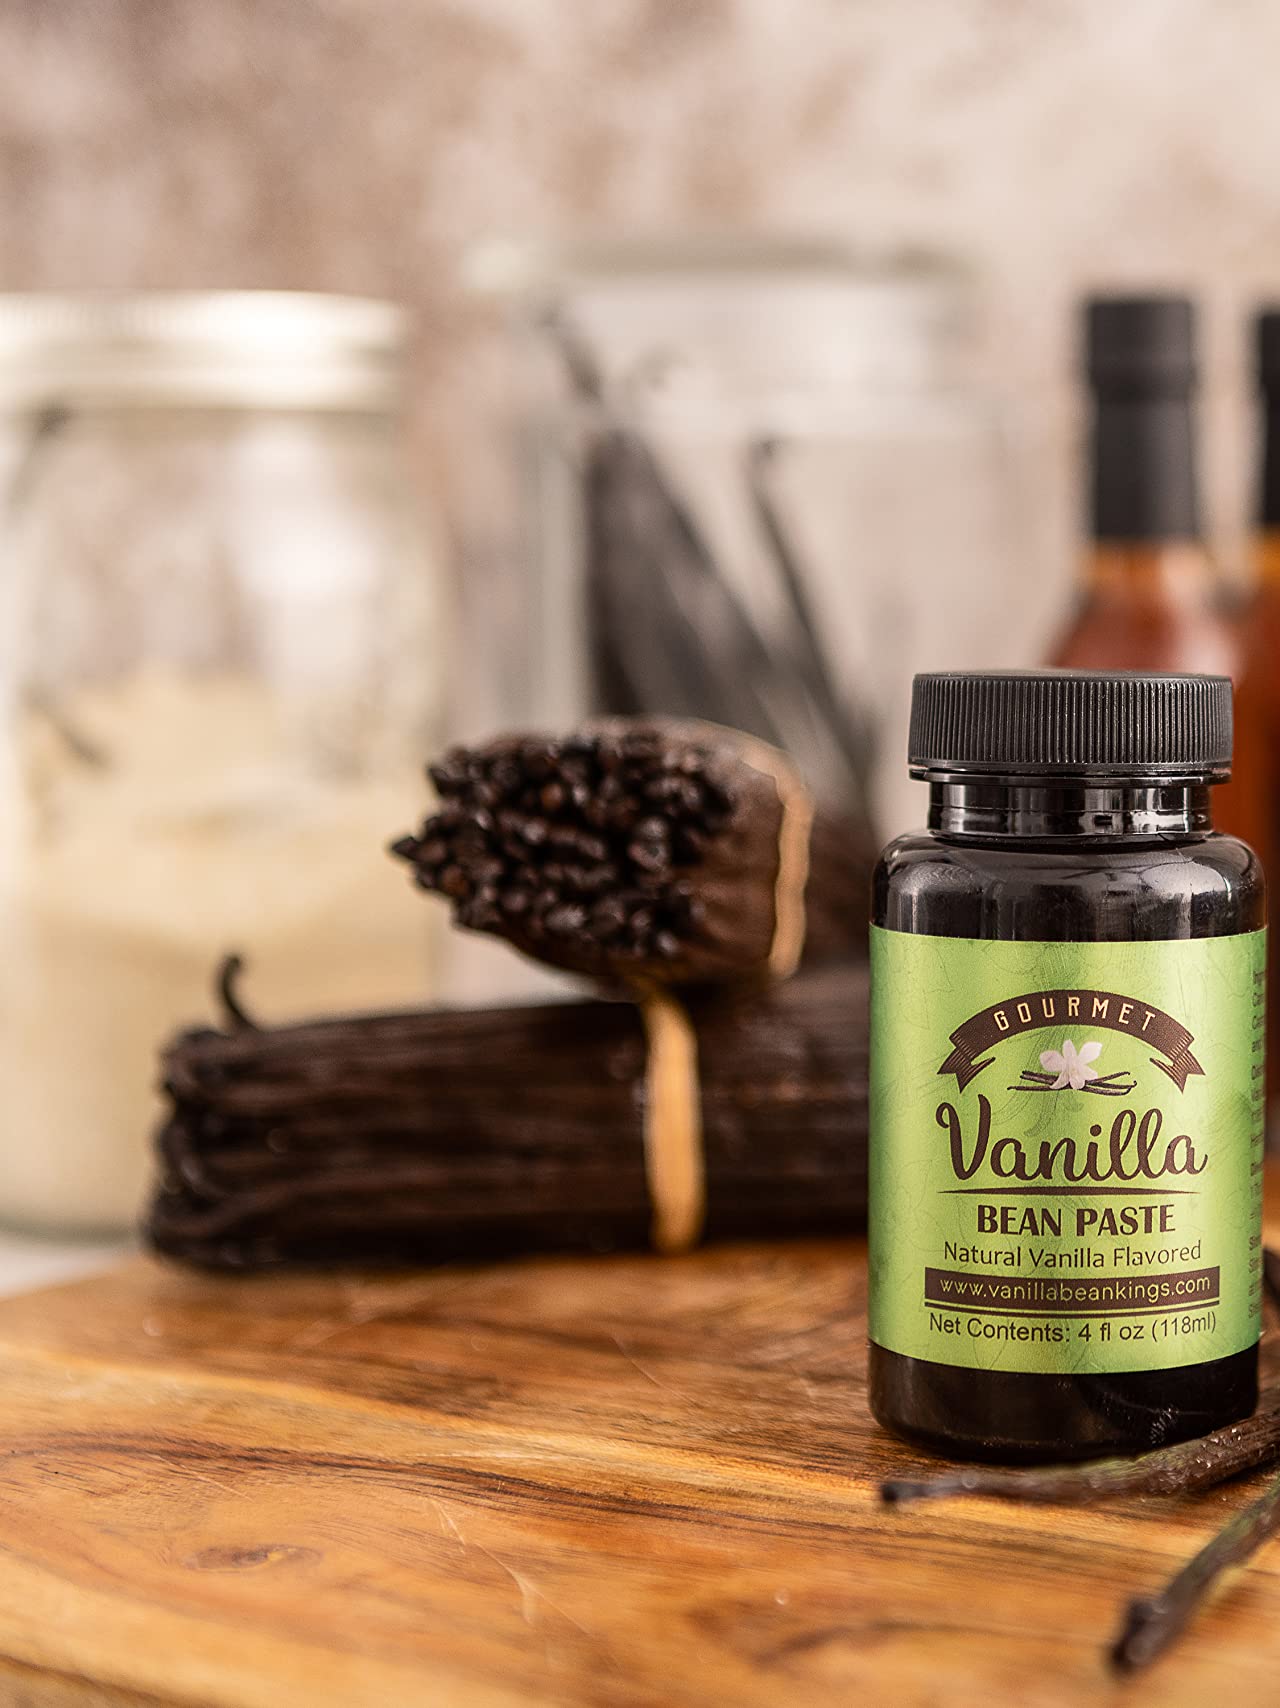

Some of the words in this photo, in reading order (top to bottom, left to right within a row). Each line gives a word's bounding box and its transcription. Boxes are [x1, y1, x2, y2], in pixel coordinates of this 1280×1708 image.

[993, 996, 1156, 1032] GOURMET
[936, 1094, 1208, 1181] Vanilla
[977, 1204, 1062, 1236] BEAN
[1076, 1204, 1176, 1236] PASTE
[944, 1241, 1021, 1267] Natural
[1030, 1246, 1105, 1268] Vanilla
[1113, 1240, 1201, 1266] Flavored
[940, 1273, 1211, 1302] www.vanillabeankings.com
[929, 1313, 961, 1334] Net
[968, 1317, 1070, 1342] Contents:
[1078, 1323, 1091, 1342] 4
[1100, 1323, 1111, 1341] fl
[1119, 1326, 1144, 1341] oz
[1151, 1313, 1216, 1342] (118ml)
